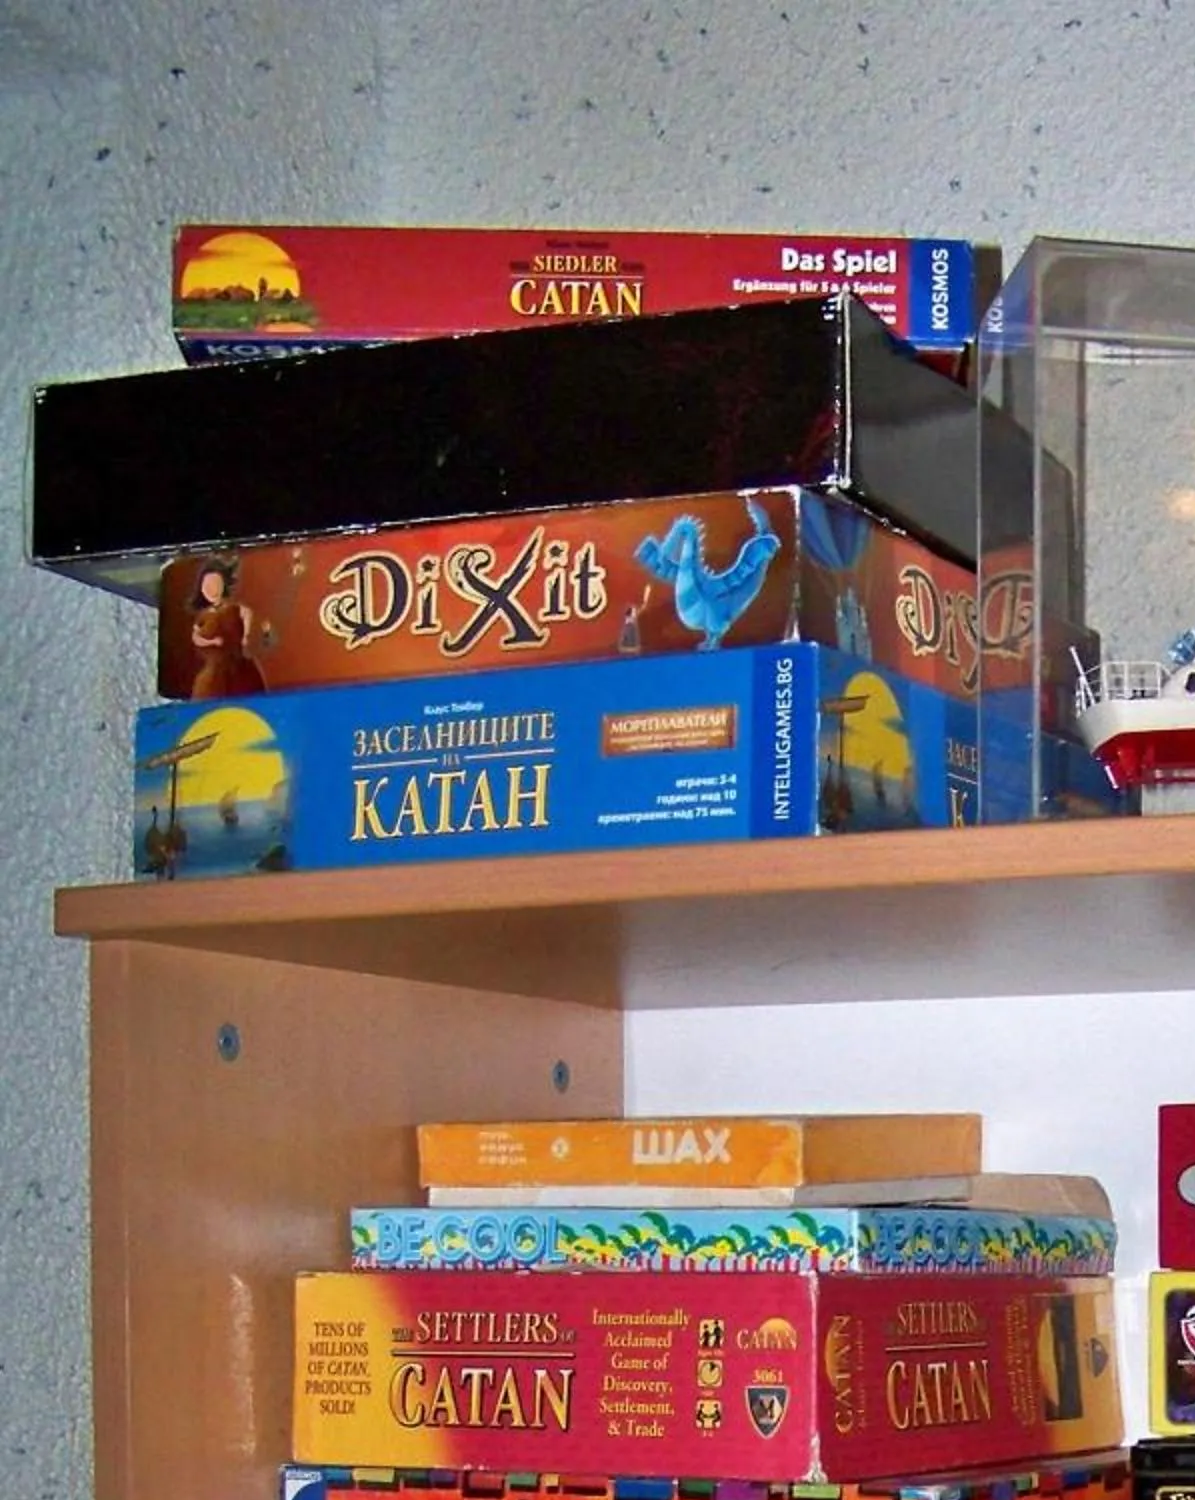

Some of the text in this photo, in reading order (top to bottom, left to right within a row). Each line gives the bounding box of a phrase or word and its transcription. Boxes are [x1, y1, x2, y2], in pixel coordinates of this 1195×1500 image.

[532, 255, 618, 273] SIEDLER
[781, 247, 897, 276] Das Spiel
[510, 279, 643, 316] CATAN
[852, 281, 897, 295] Spieler
[931, 247, 949, 330] KOSMOS
[352, 710, 556, 757] ЗАСЕЛНИЦИТЕ
[773, 657, 793, 820] INTELLIGAMES.BG
[350, 763, 553, 842] КАТАН
[723, 789, 737, 800] 10
[632, 1128, 731, 1166] ШАХ
[376, 1213, 568, 1265] BE COOL
[415, 1311, 559, 1344] SETTLERS
[592, 1308, 691, 1331] Internationally
[897, 1301, 978, 1335] SETTLERS
[313, 1322, 366, 1338] TENS OF
[603, 1331, 673, 1349] Acclaimed
[736, 1328, 798, 1350] CATAN
[307, 1342, 369, 1358] MILLIONS
[610, 1352, 670, 1370] Game of
[306, 1362, 325, 1376] OF
[834, 1314, 854, 1433] CATAN
[304, 1380, 372, 1396] PRODUCTS
[389, 1361, 576, 1432] CATAN
[602, 1375, 673, 1398] Discovery,
[885, 1359, 992, 1430] CATAN
[318, 1399, 356, 1415] SOLD!
[599, 1398, 675, 1416] Settlement,
[607, 1419, 665, 1438] & Trade
